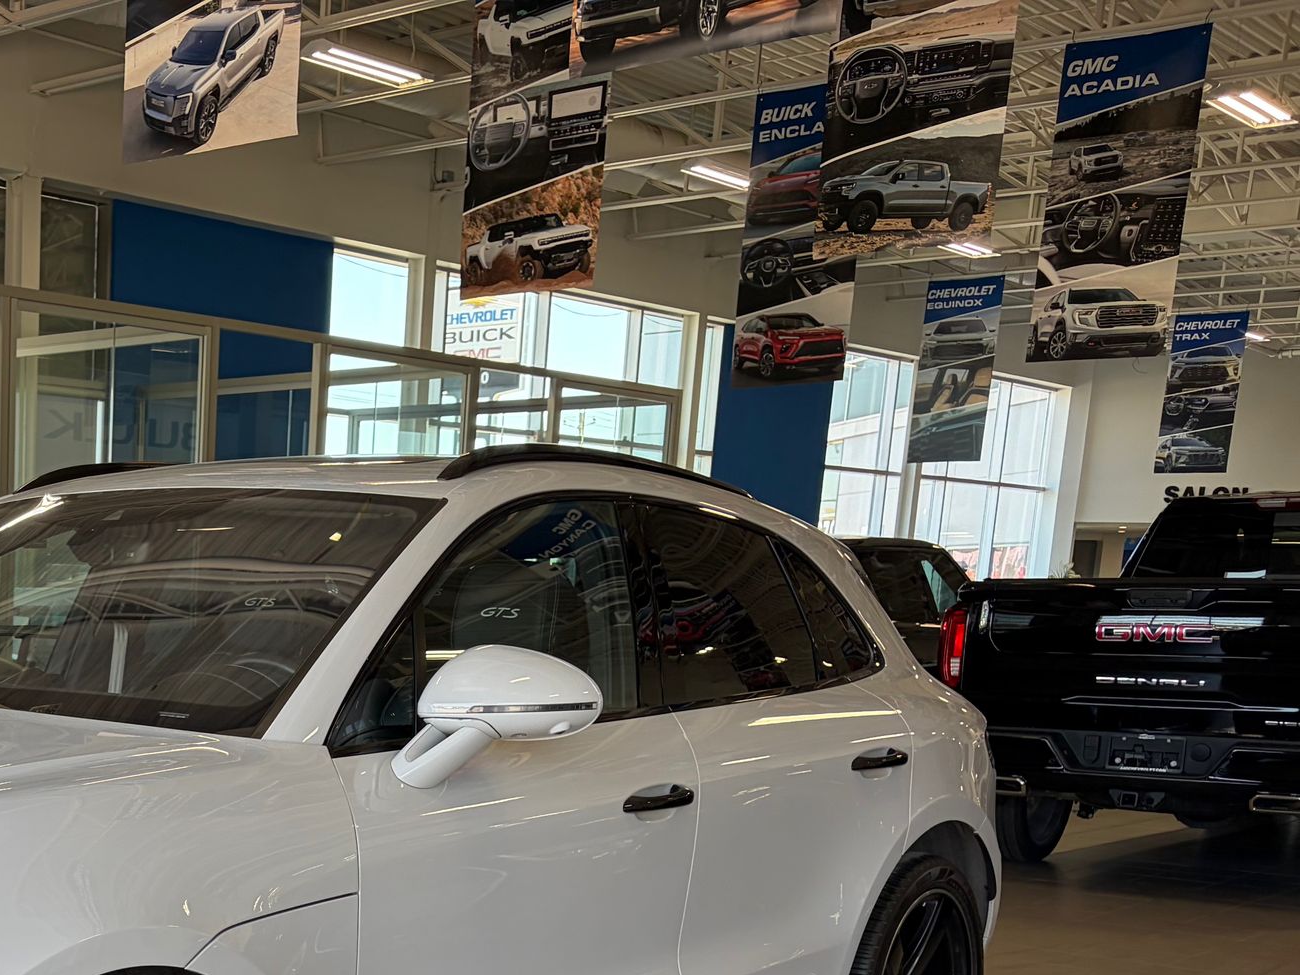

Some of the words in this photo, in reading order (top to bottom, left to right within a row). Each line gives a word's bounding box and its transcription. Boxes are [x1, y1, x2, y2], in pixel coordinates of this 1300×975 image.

[1067, 55, 1119, 77] GMC
[1064, 73, 1159, 97] ACADIA
[760, 101, 816, 124] BUICK
[759, 122, 825, 142] ENCLA
[928, 285, 996, 299] CHEVROLET
[927, 299, 983, 310] EQUINOX
[1176, 320, 1240, 331] CHEVROLET
[445, 327, 516, 344] BUICK
[1175, 332, 1210, 341] TRAX
[244, 597, 277, 608] GTS
[480, 606, 520, 619] GTS
[1095, 623, 1220, 643] GMC
